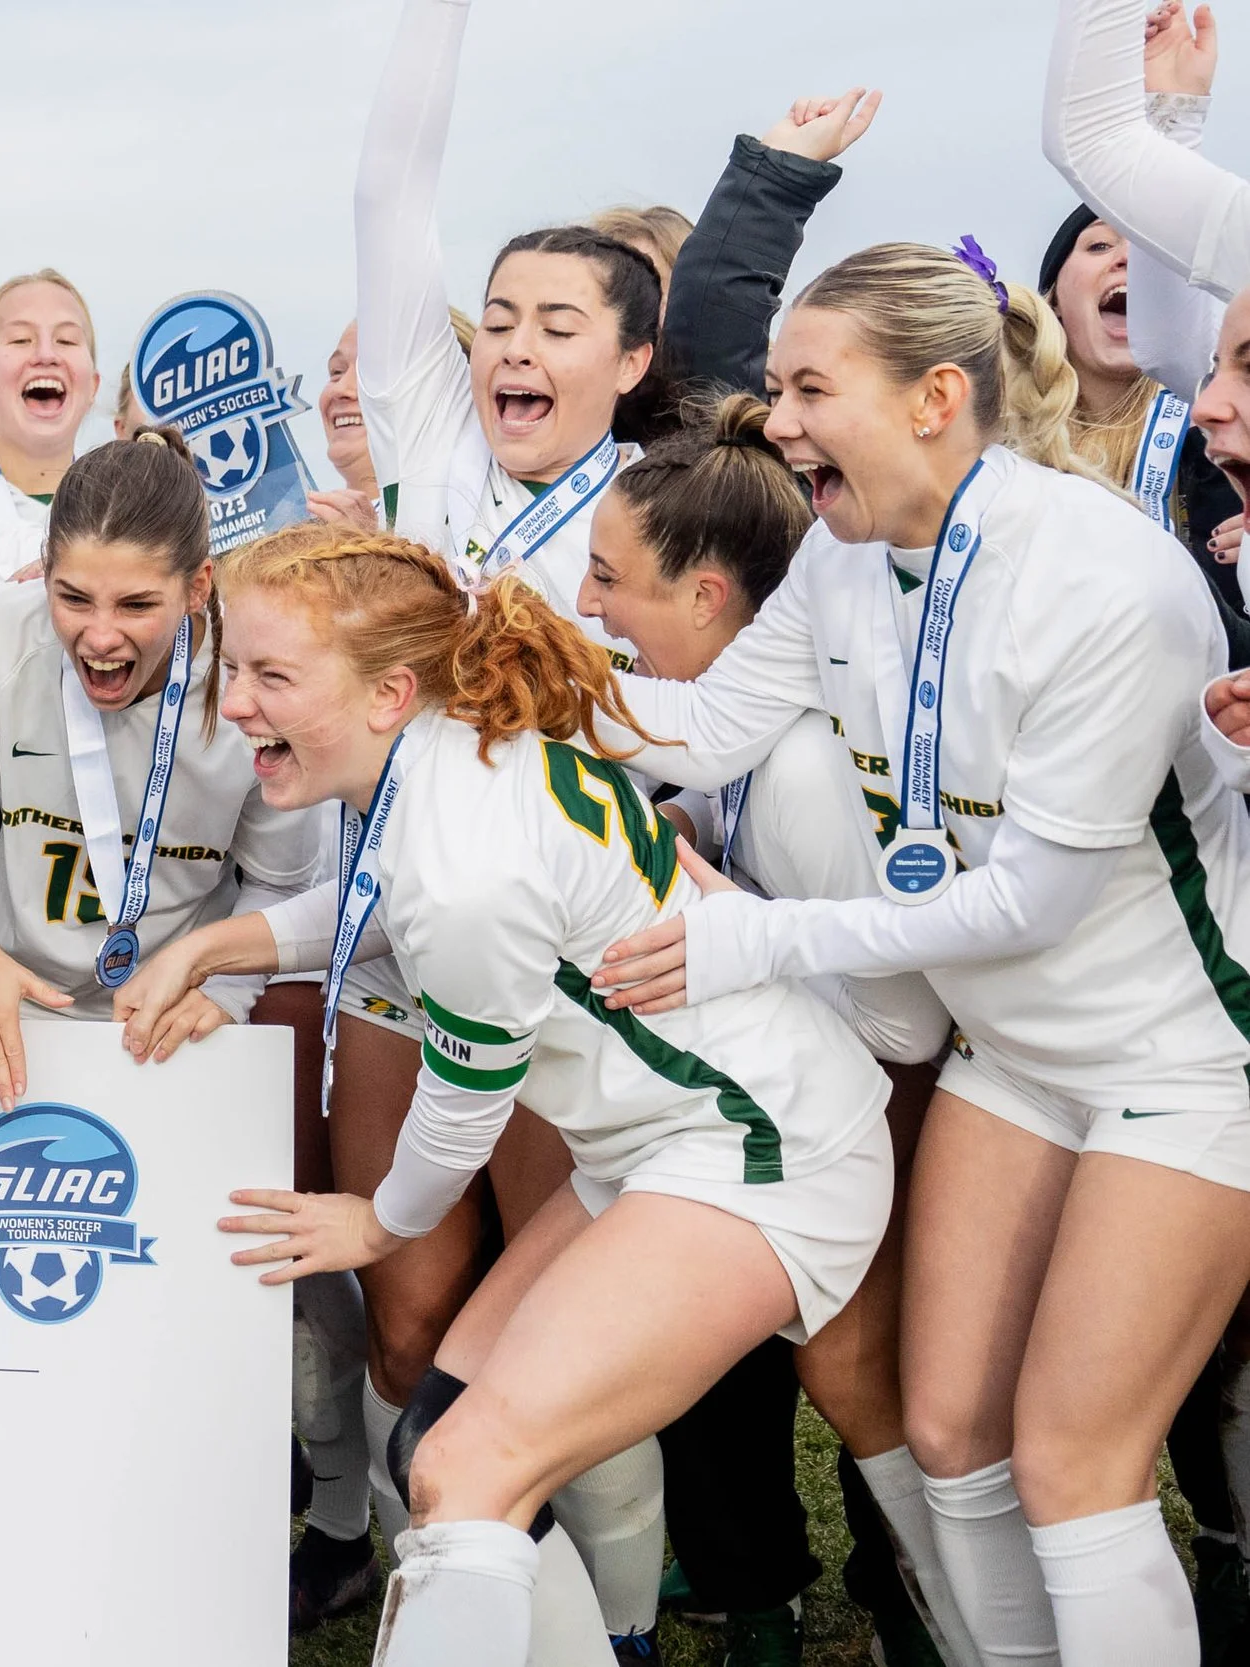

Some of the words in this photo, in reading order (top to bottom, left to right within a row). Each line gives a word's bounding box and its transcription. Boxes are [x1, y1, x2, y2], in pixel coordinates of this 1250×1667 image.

[153, 337, 250, 408] GLIAC
[171, 402, 217, 434] OMEN'S
[219, 386, 269, 415] SOCCER
[209, 494, 247, 522] 023
[514, 495, 559, 538] TOURNAMENT
[1152, 471, 1166, 521] CHAMPIONS
[208, 509, 266, 542] RNAMENT
[208, 527, 266, 557] AMPIONS
[523, 506, 563, 545] CHAMPIONS
[925, 578, 944, 650] CHAMPIONS
[932, 576, 955, 661] TOURNAMENT
[149, 725, 168, 797] TOURNAMENT
[155, 732, 173, 794] CHAMPIONS
[911, 734, 924, 803] CHAMPIONS
[921, 732, 934, 813] TOURNAMENT
[367, 776, 400, 851] TOURNAMENT
[123, 861, 142, 924] OURNAMENT
[427, 1018, 471, 1062] PTAIN
[7, 1229, 92, 1243] TOURNAMENT
[57, 1220, 102, 1233] SOCCER
